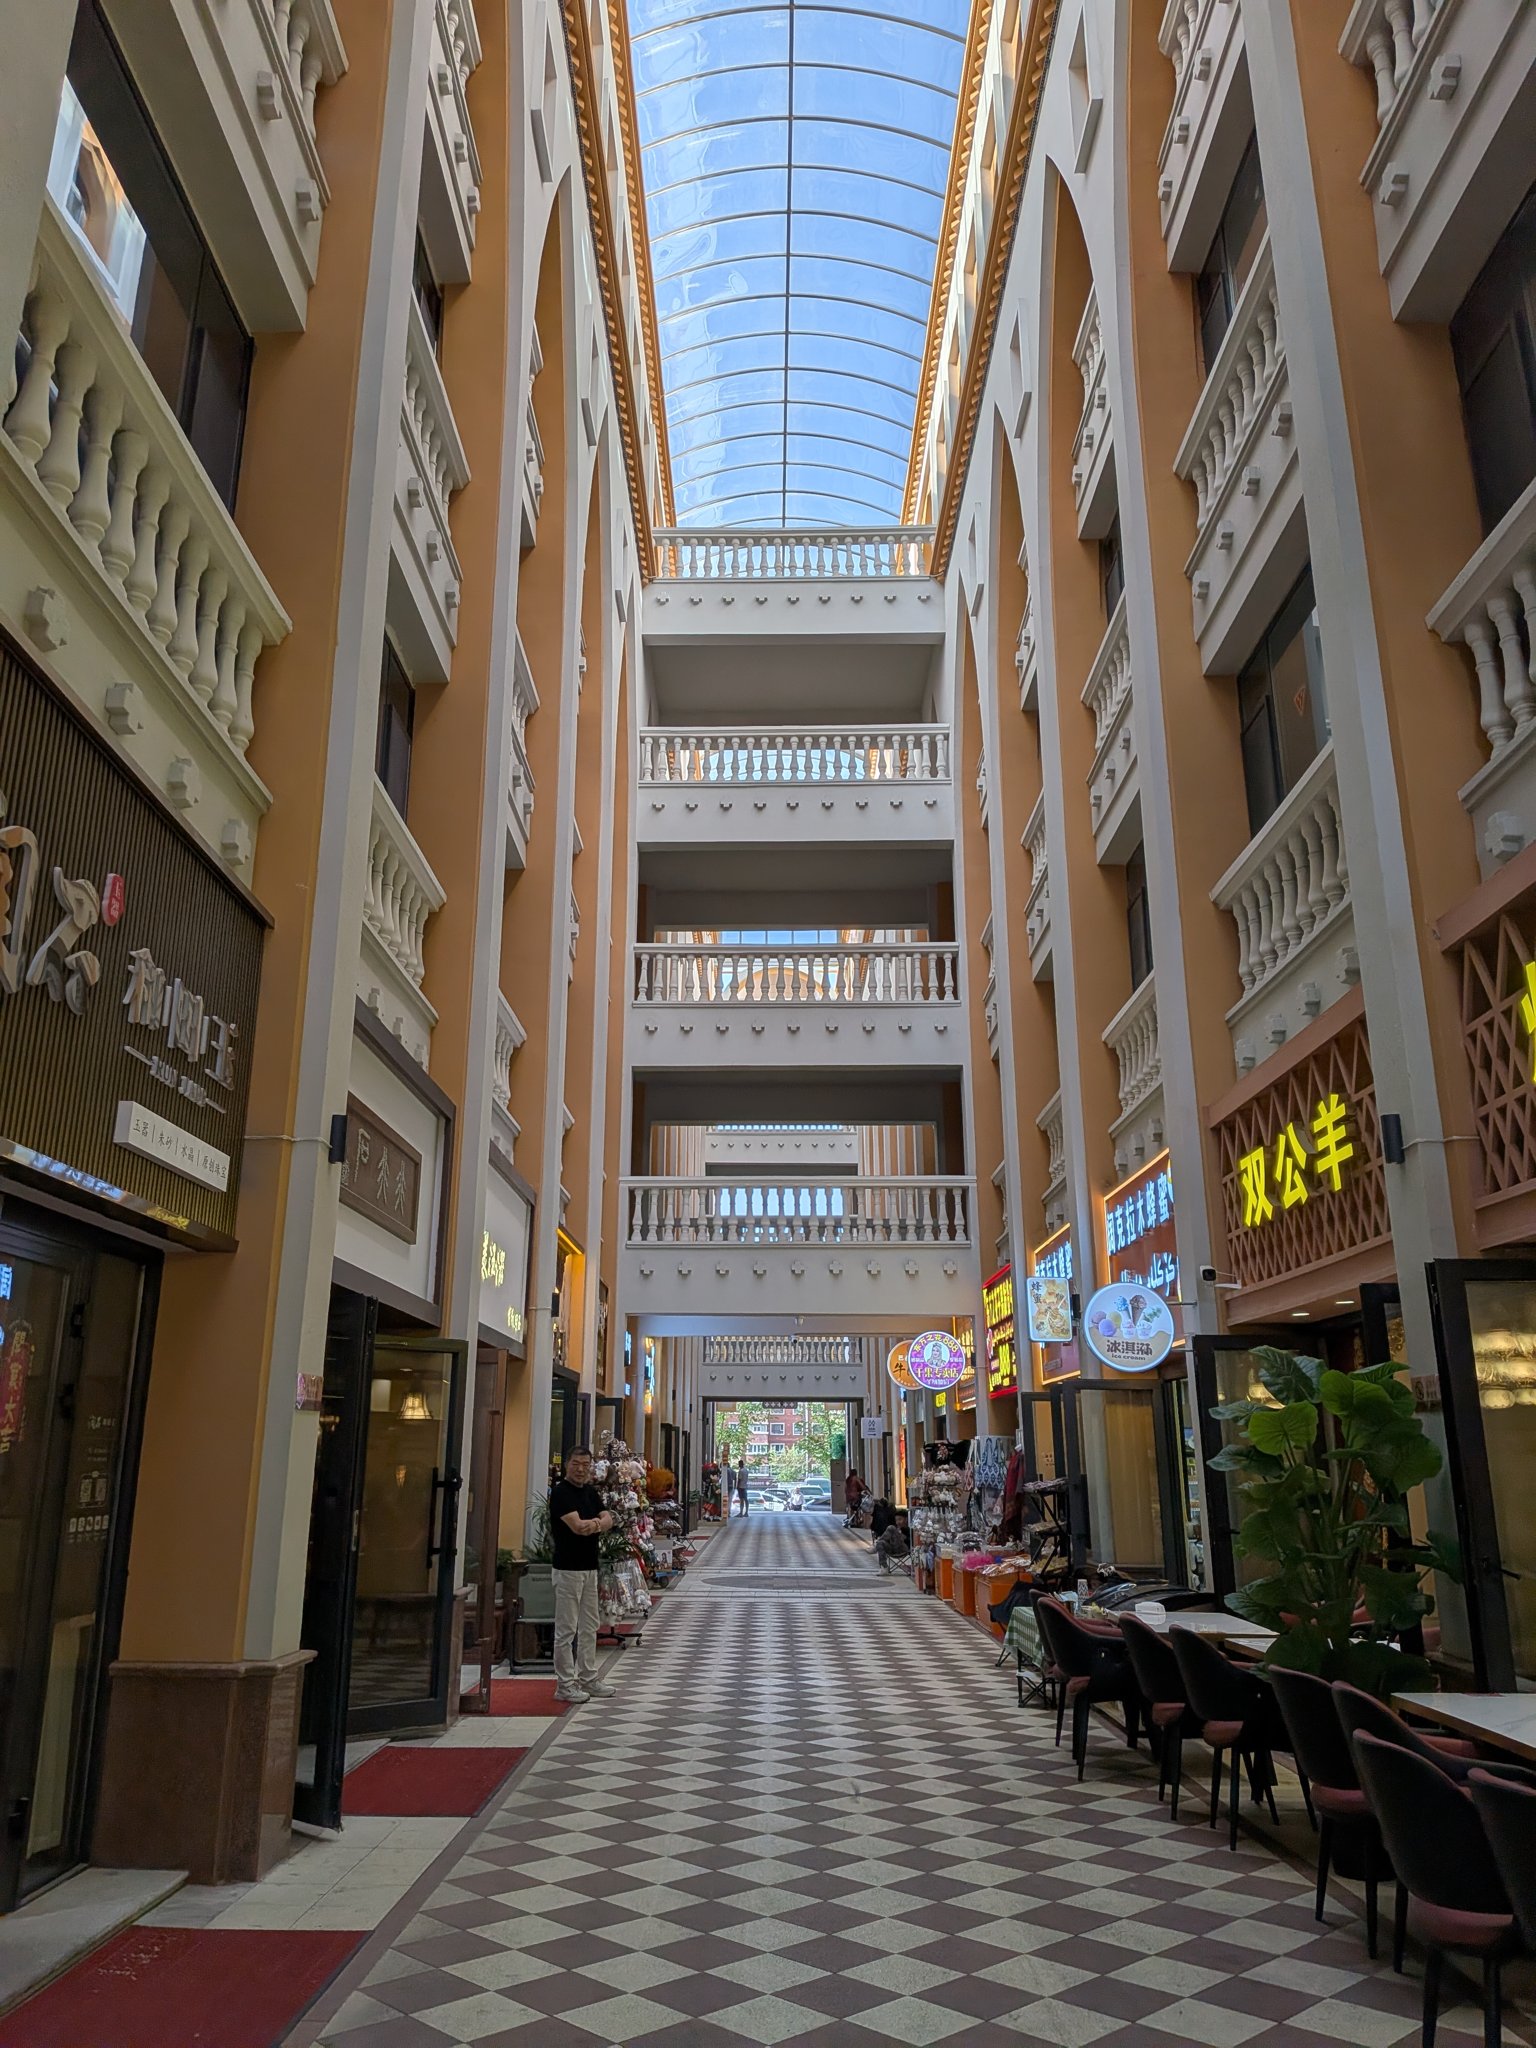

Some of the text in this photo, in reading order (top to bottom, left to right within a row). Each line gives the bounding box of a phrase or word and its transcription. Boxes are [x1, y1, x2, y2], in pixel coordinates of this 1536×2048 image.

[133, 1118, 149, 1137] 玉器
[180, 1143, 194, 1163] 水晶
[1239, 1093, 1355, 1227] 双公羊
[1031, 1281, 1042, 1304] 蜂蜜
[913, 1334, 959, 1353] 东方之花888
[893, 1362, 909, 1377] 牛
[915, 1367, 959, 1378] 干果专卖店
